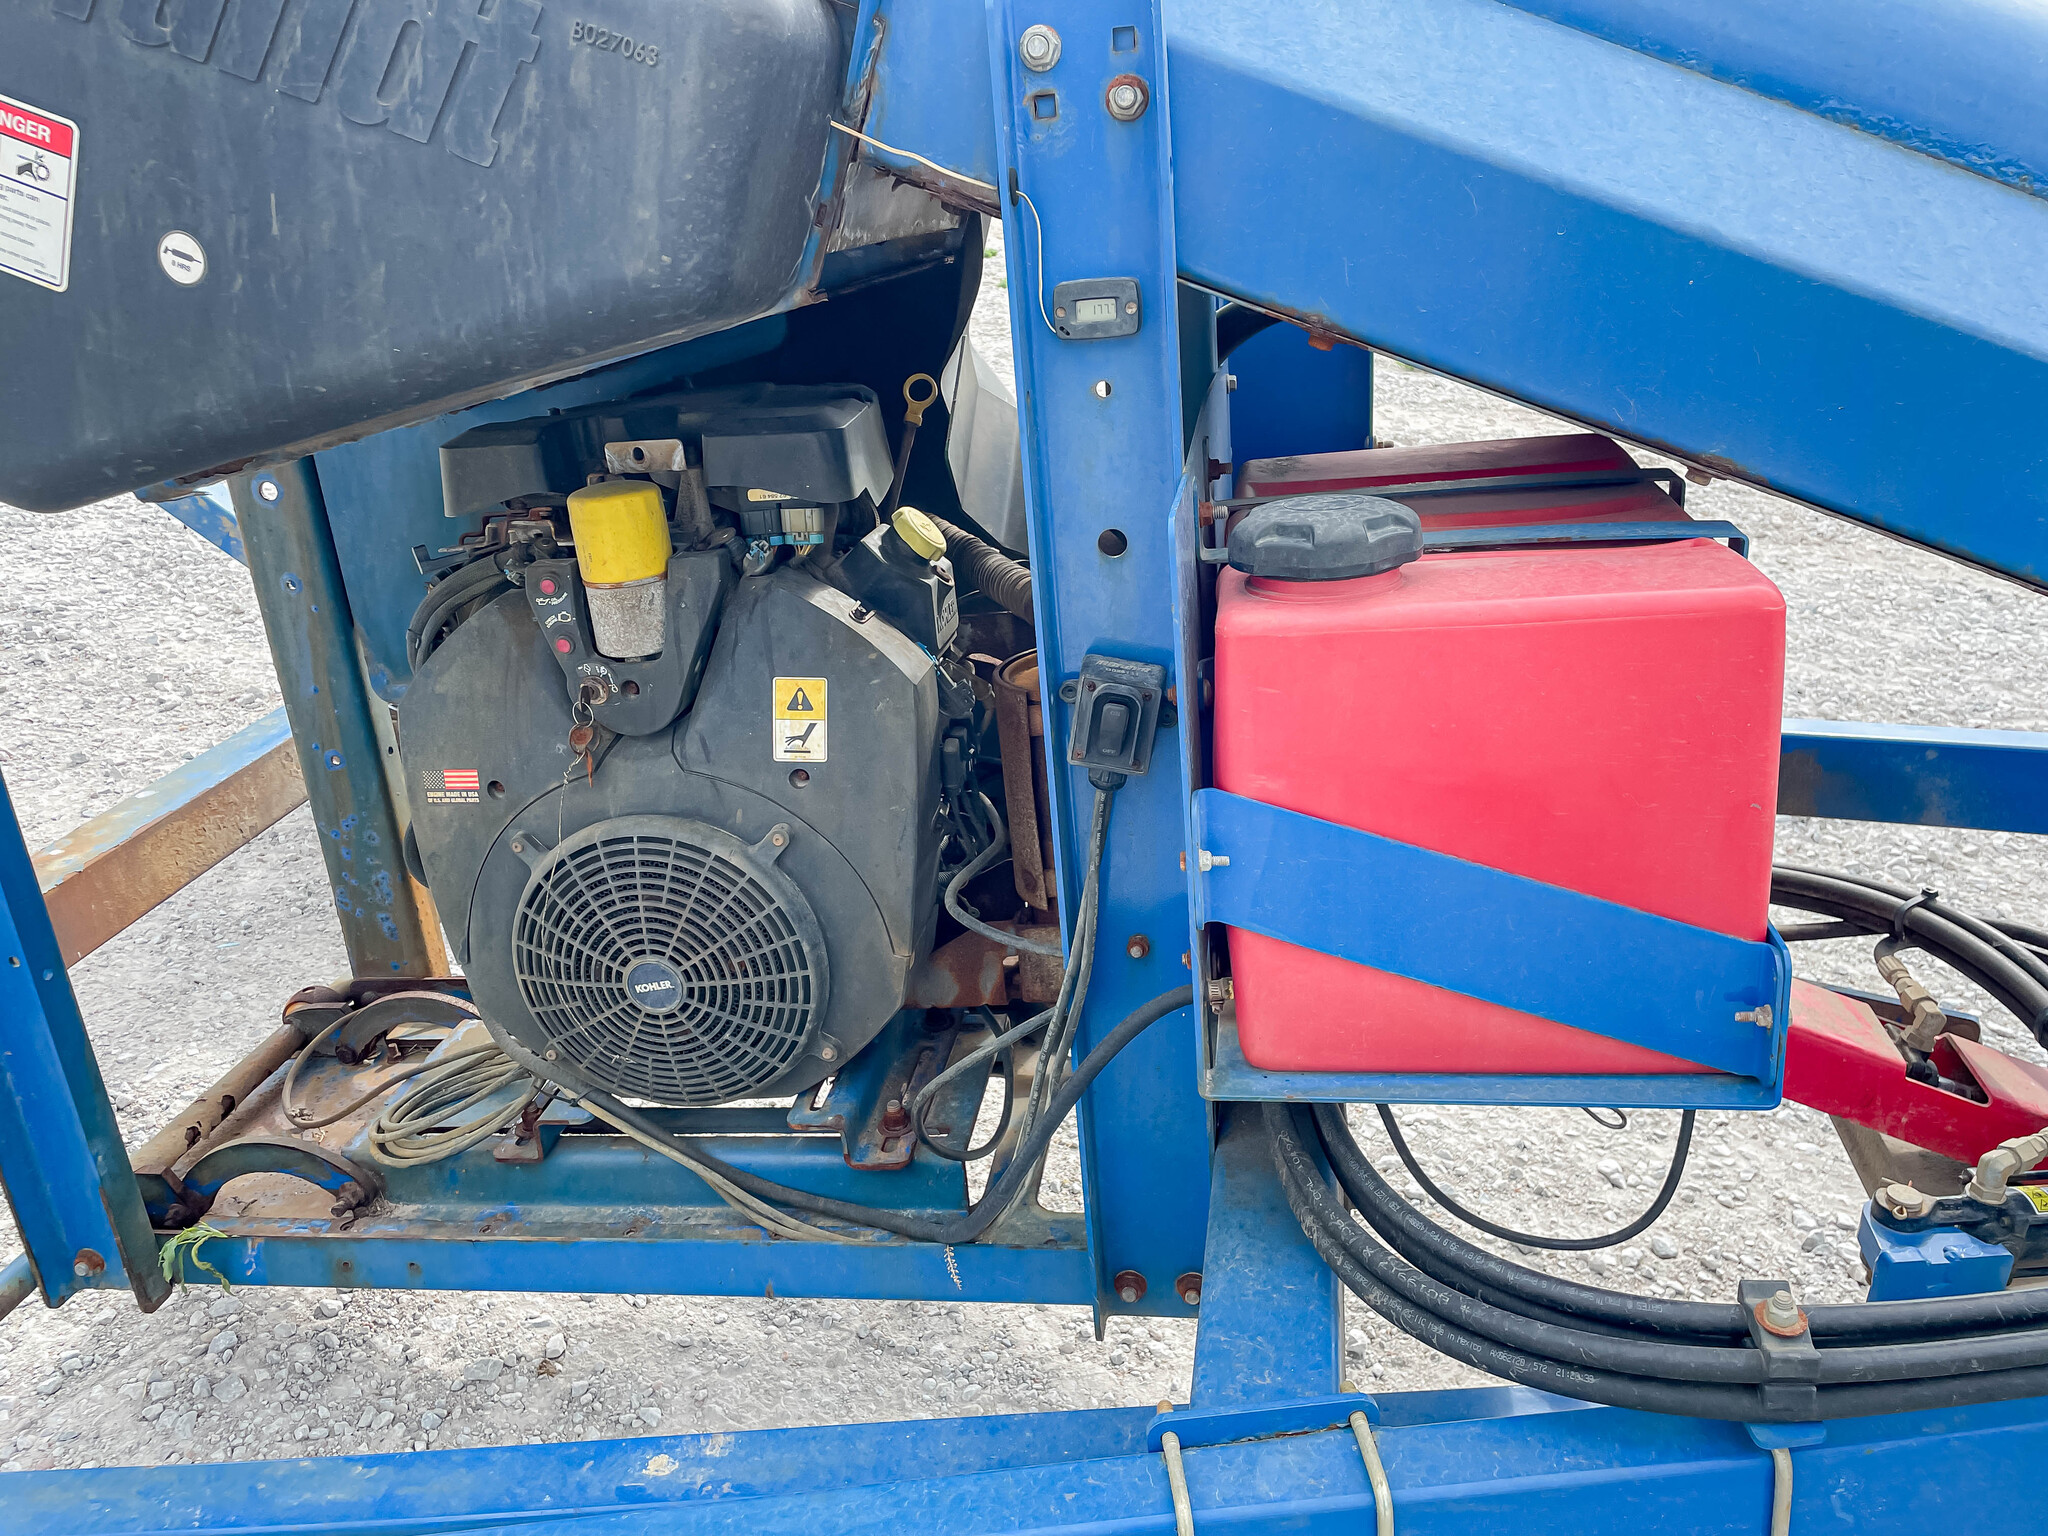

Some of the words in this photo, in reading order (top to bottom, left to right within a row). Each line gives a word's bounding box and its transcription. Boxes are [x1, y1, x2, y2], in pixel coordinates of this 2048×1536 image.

[176, 262, 190, 272] HRS
[1635, 1300, 1663, 1313] GATES
[1427, 1320, 1444, 1336] Made
[1448, 1333, 1454, 1342] in
[1456, 1335, 1482, 1352] Mexico
[1533, 1362, 1548, 1374] 572
